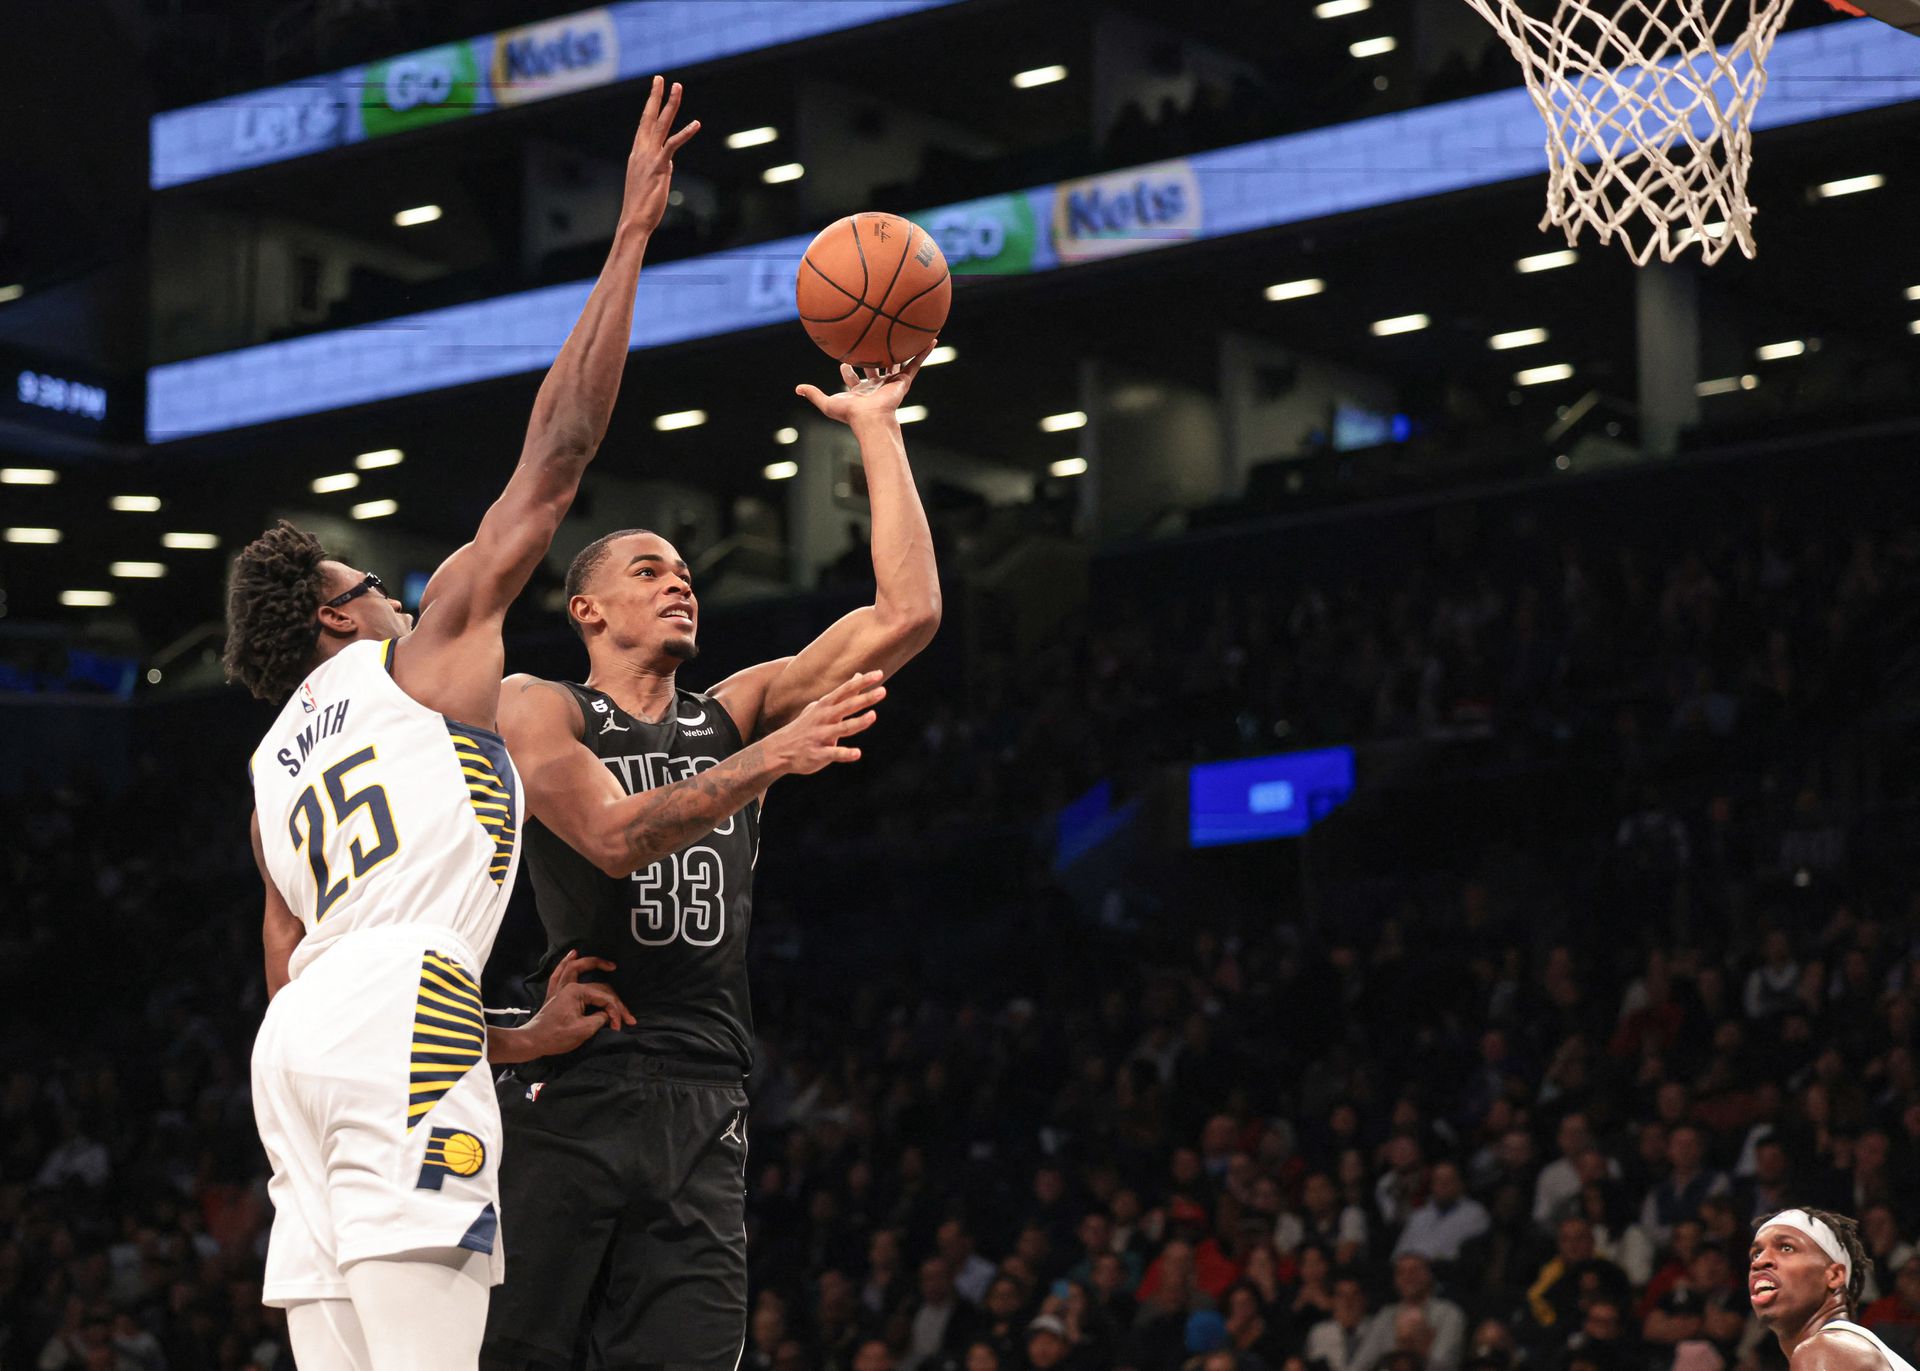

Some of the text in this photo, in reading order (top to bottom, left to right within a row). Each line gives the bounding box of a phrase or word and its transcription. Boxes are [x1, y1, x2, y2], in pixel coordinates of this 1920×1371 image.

[386, 61, 451, 111] Go
[277, 699, 350, 778] SMITH
[591, 699, 608, 713] 6
[288, 743, 400, 924] 25
[631, 845, 725, 947] 33
